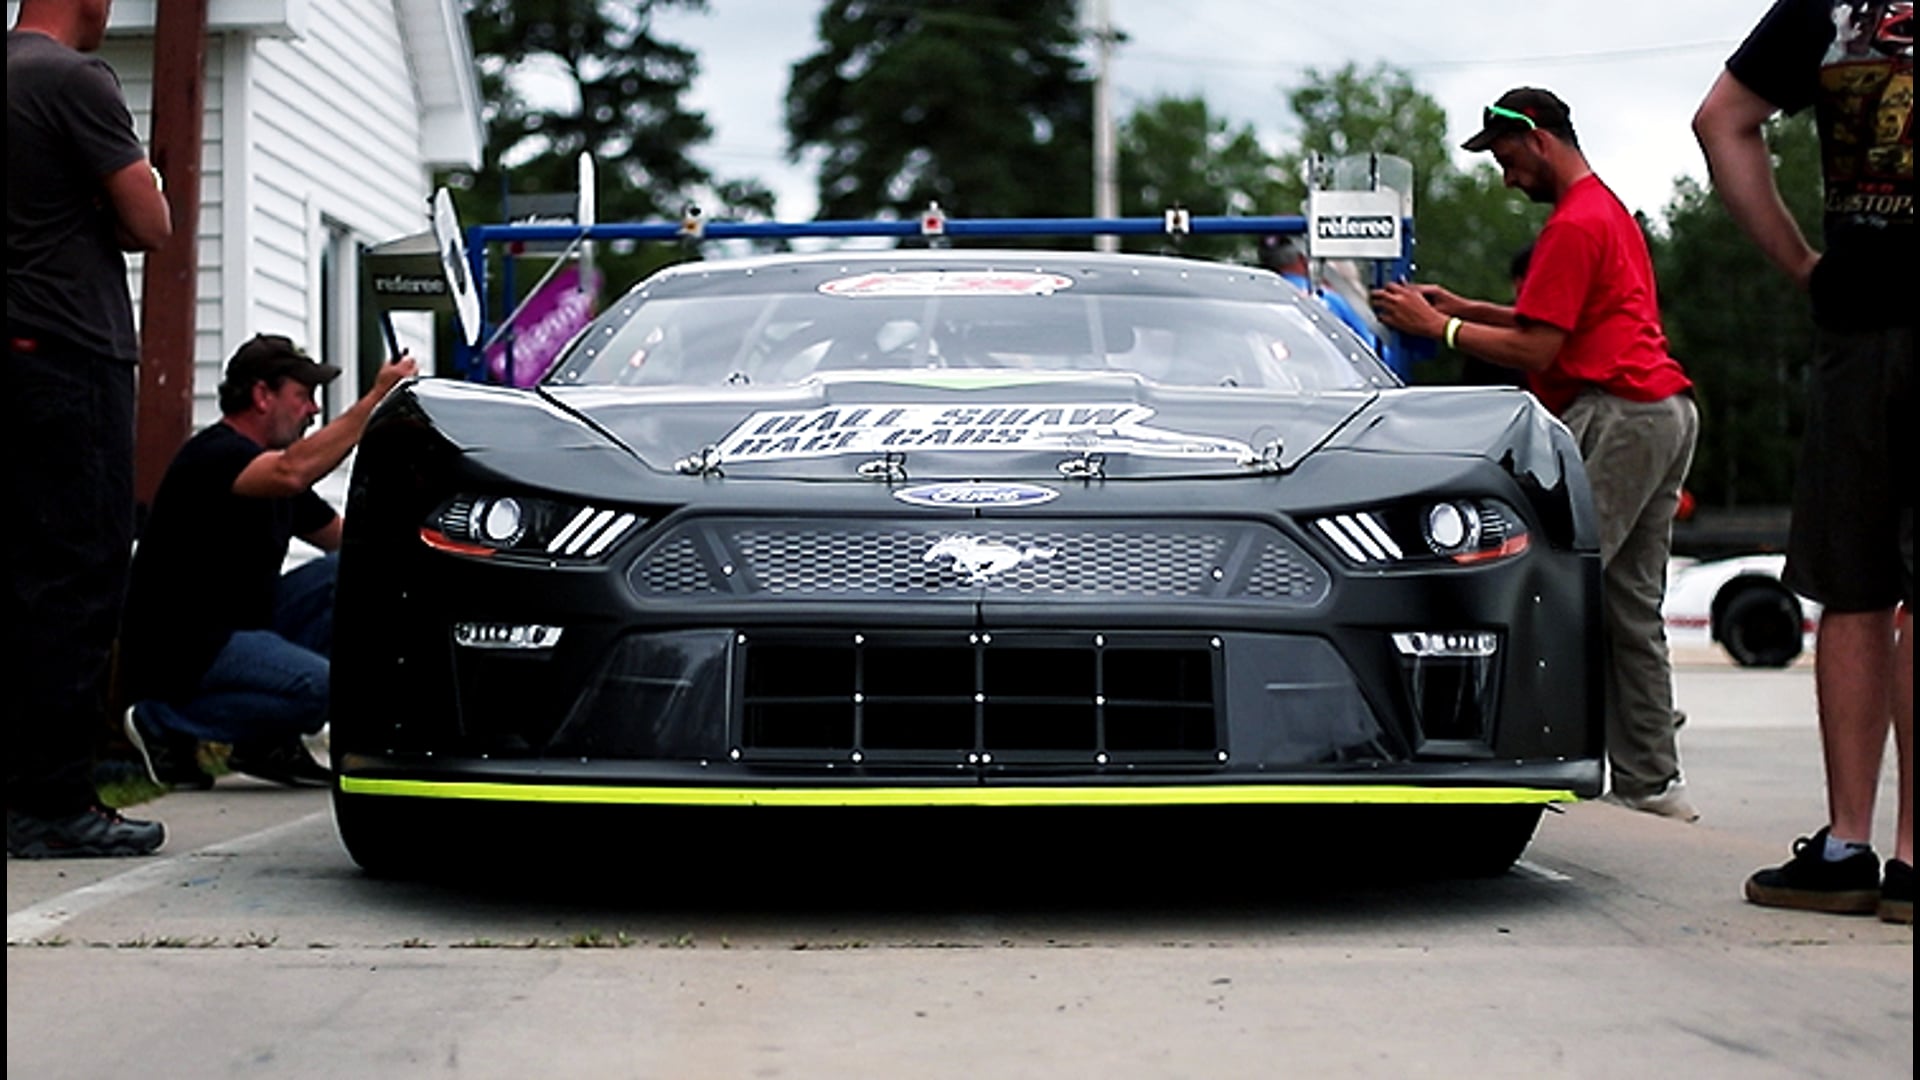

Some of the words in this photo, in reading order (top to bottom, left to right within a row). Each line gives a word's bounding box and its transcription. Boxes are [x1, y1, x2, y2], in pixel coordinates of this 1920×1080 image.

[1319, 215, 1393, 236] referee
[375, 275, 445, 293] referee
[931, 408, 1135, 427] SHAW
[730, 430, 864, 455] RACE
[881, 428, 1029, 445] CARS
[931, 487, 1019, 503] Ford
